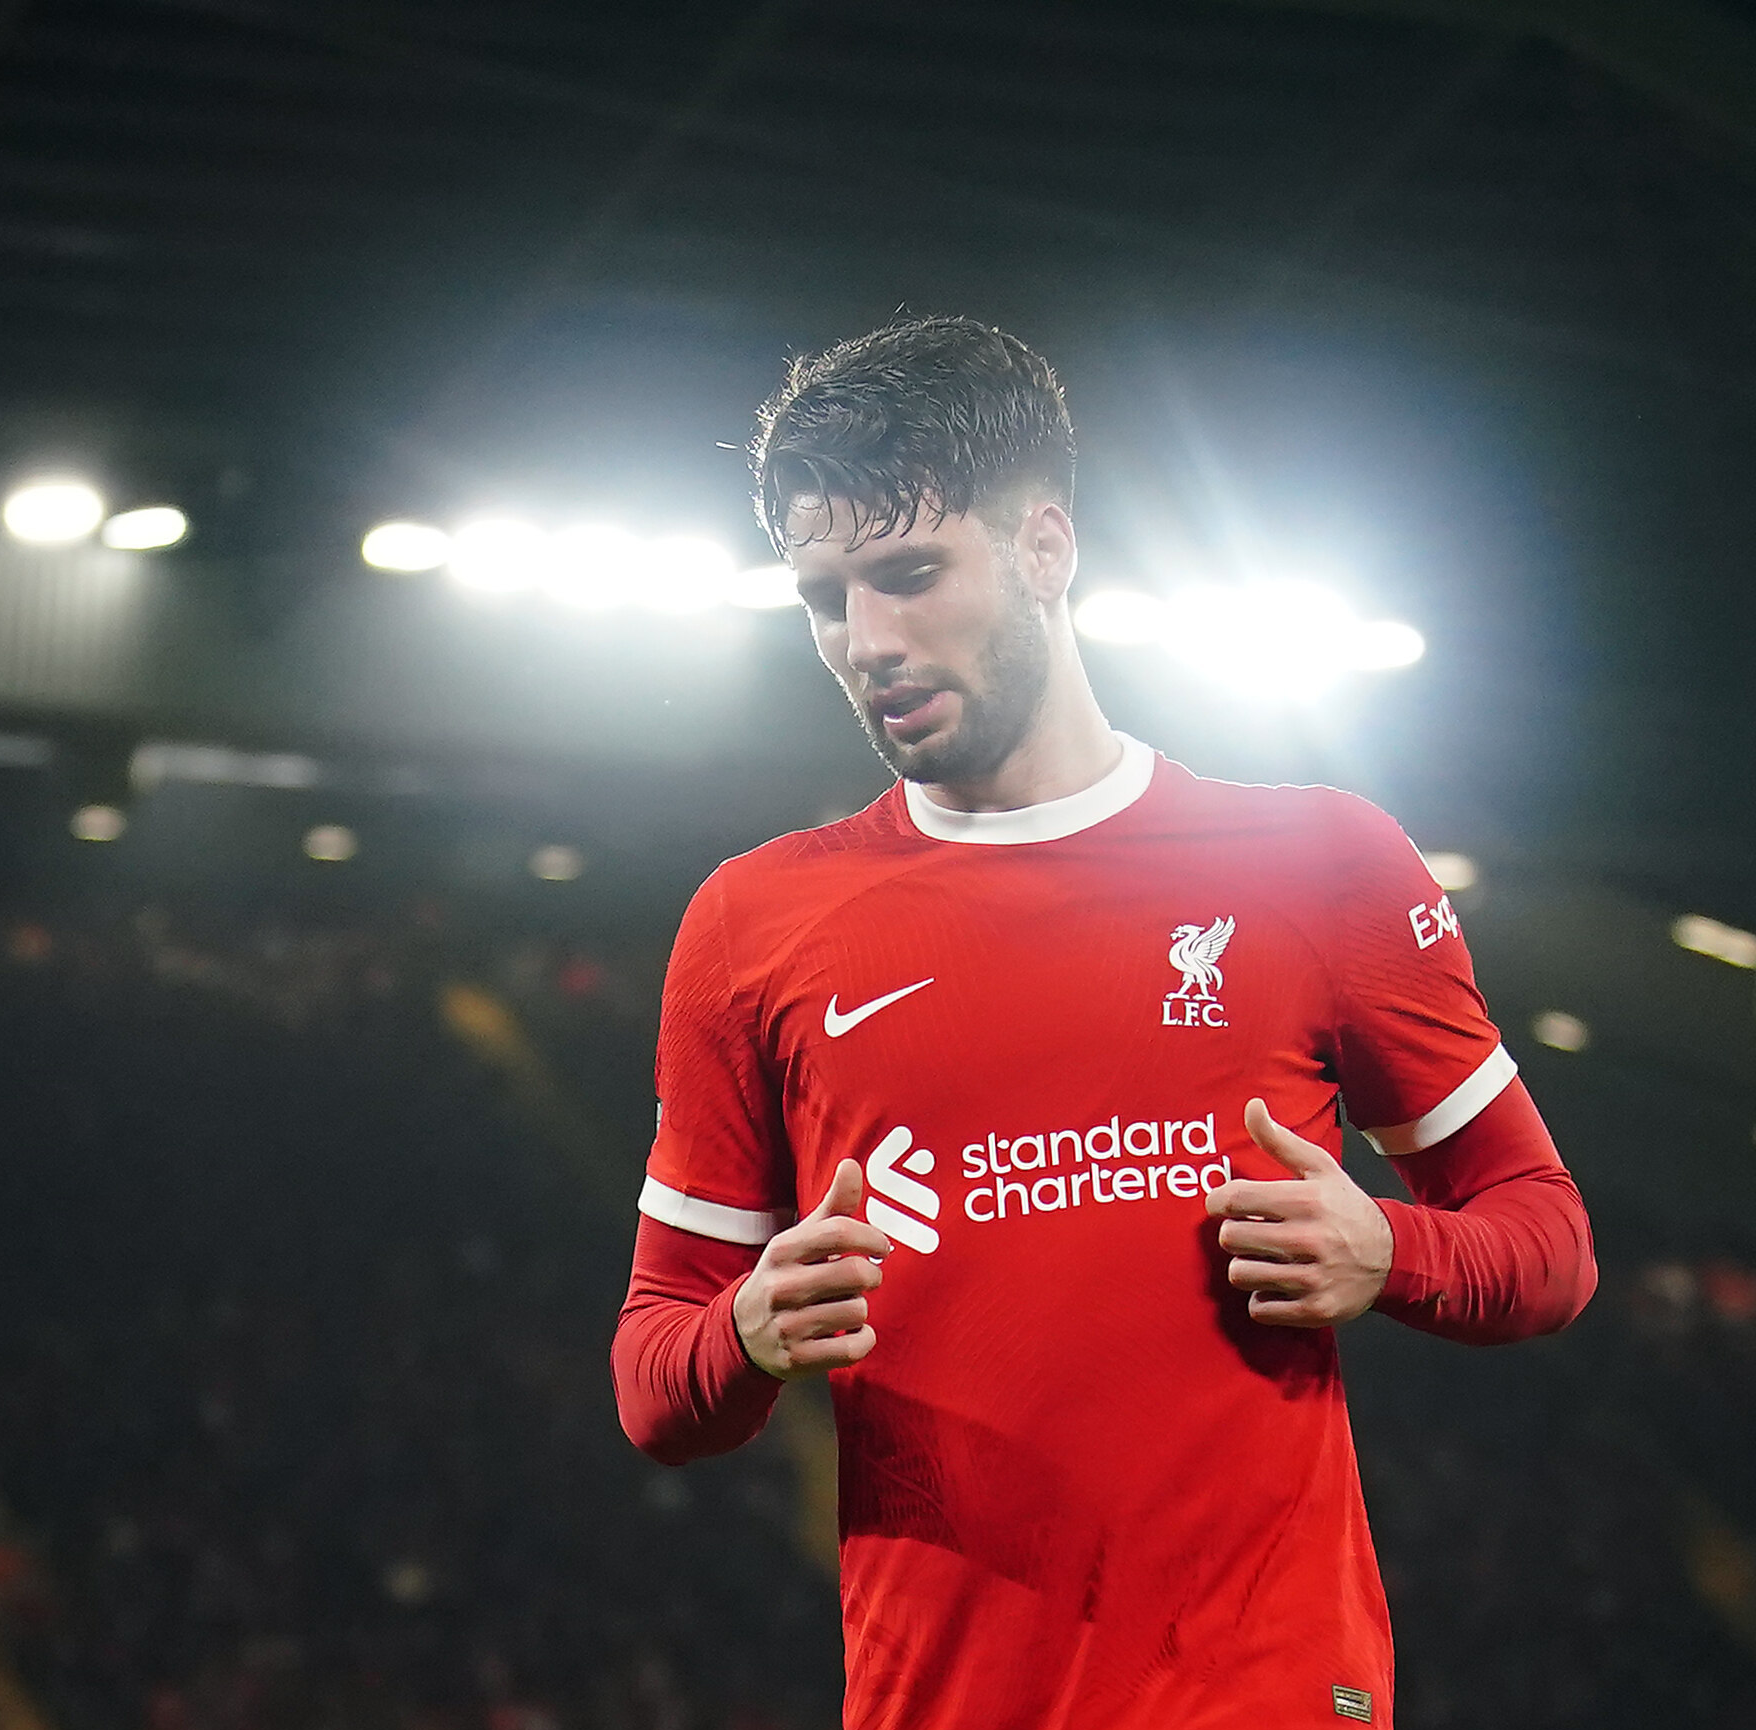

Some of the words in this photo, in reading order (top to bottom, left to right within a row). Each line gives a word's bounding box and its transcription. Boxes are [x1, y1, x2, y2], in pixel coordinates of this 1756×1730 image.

[1162, 1001, 1229, 1027] L.F.C.
[962, 1112, 1217, 1179] standard
[964, 1155, 1232, 1222] chartered
